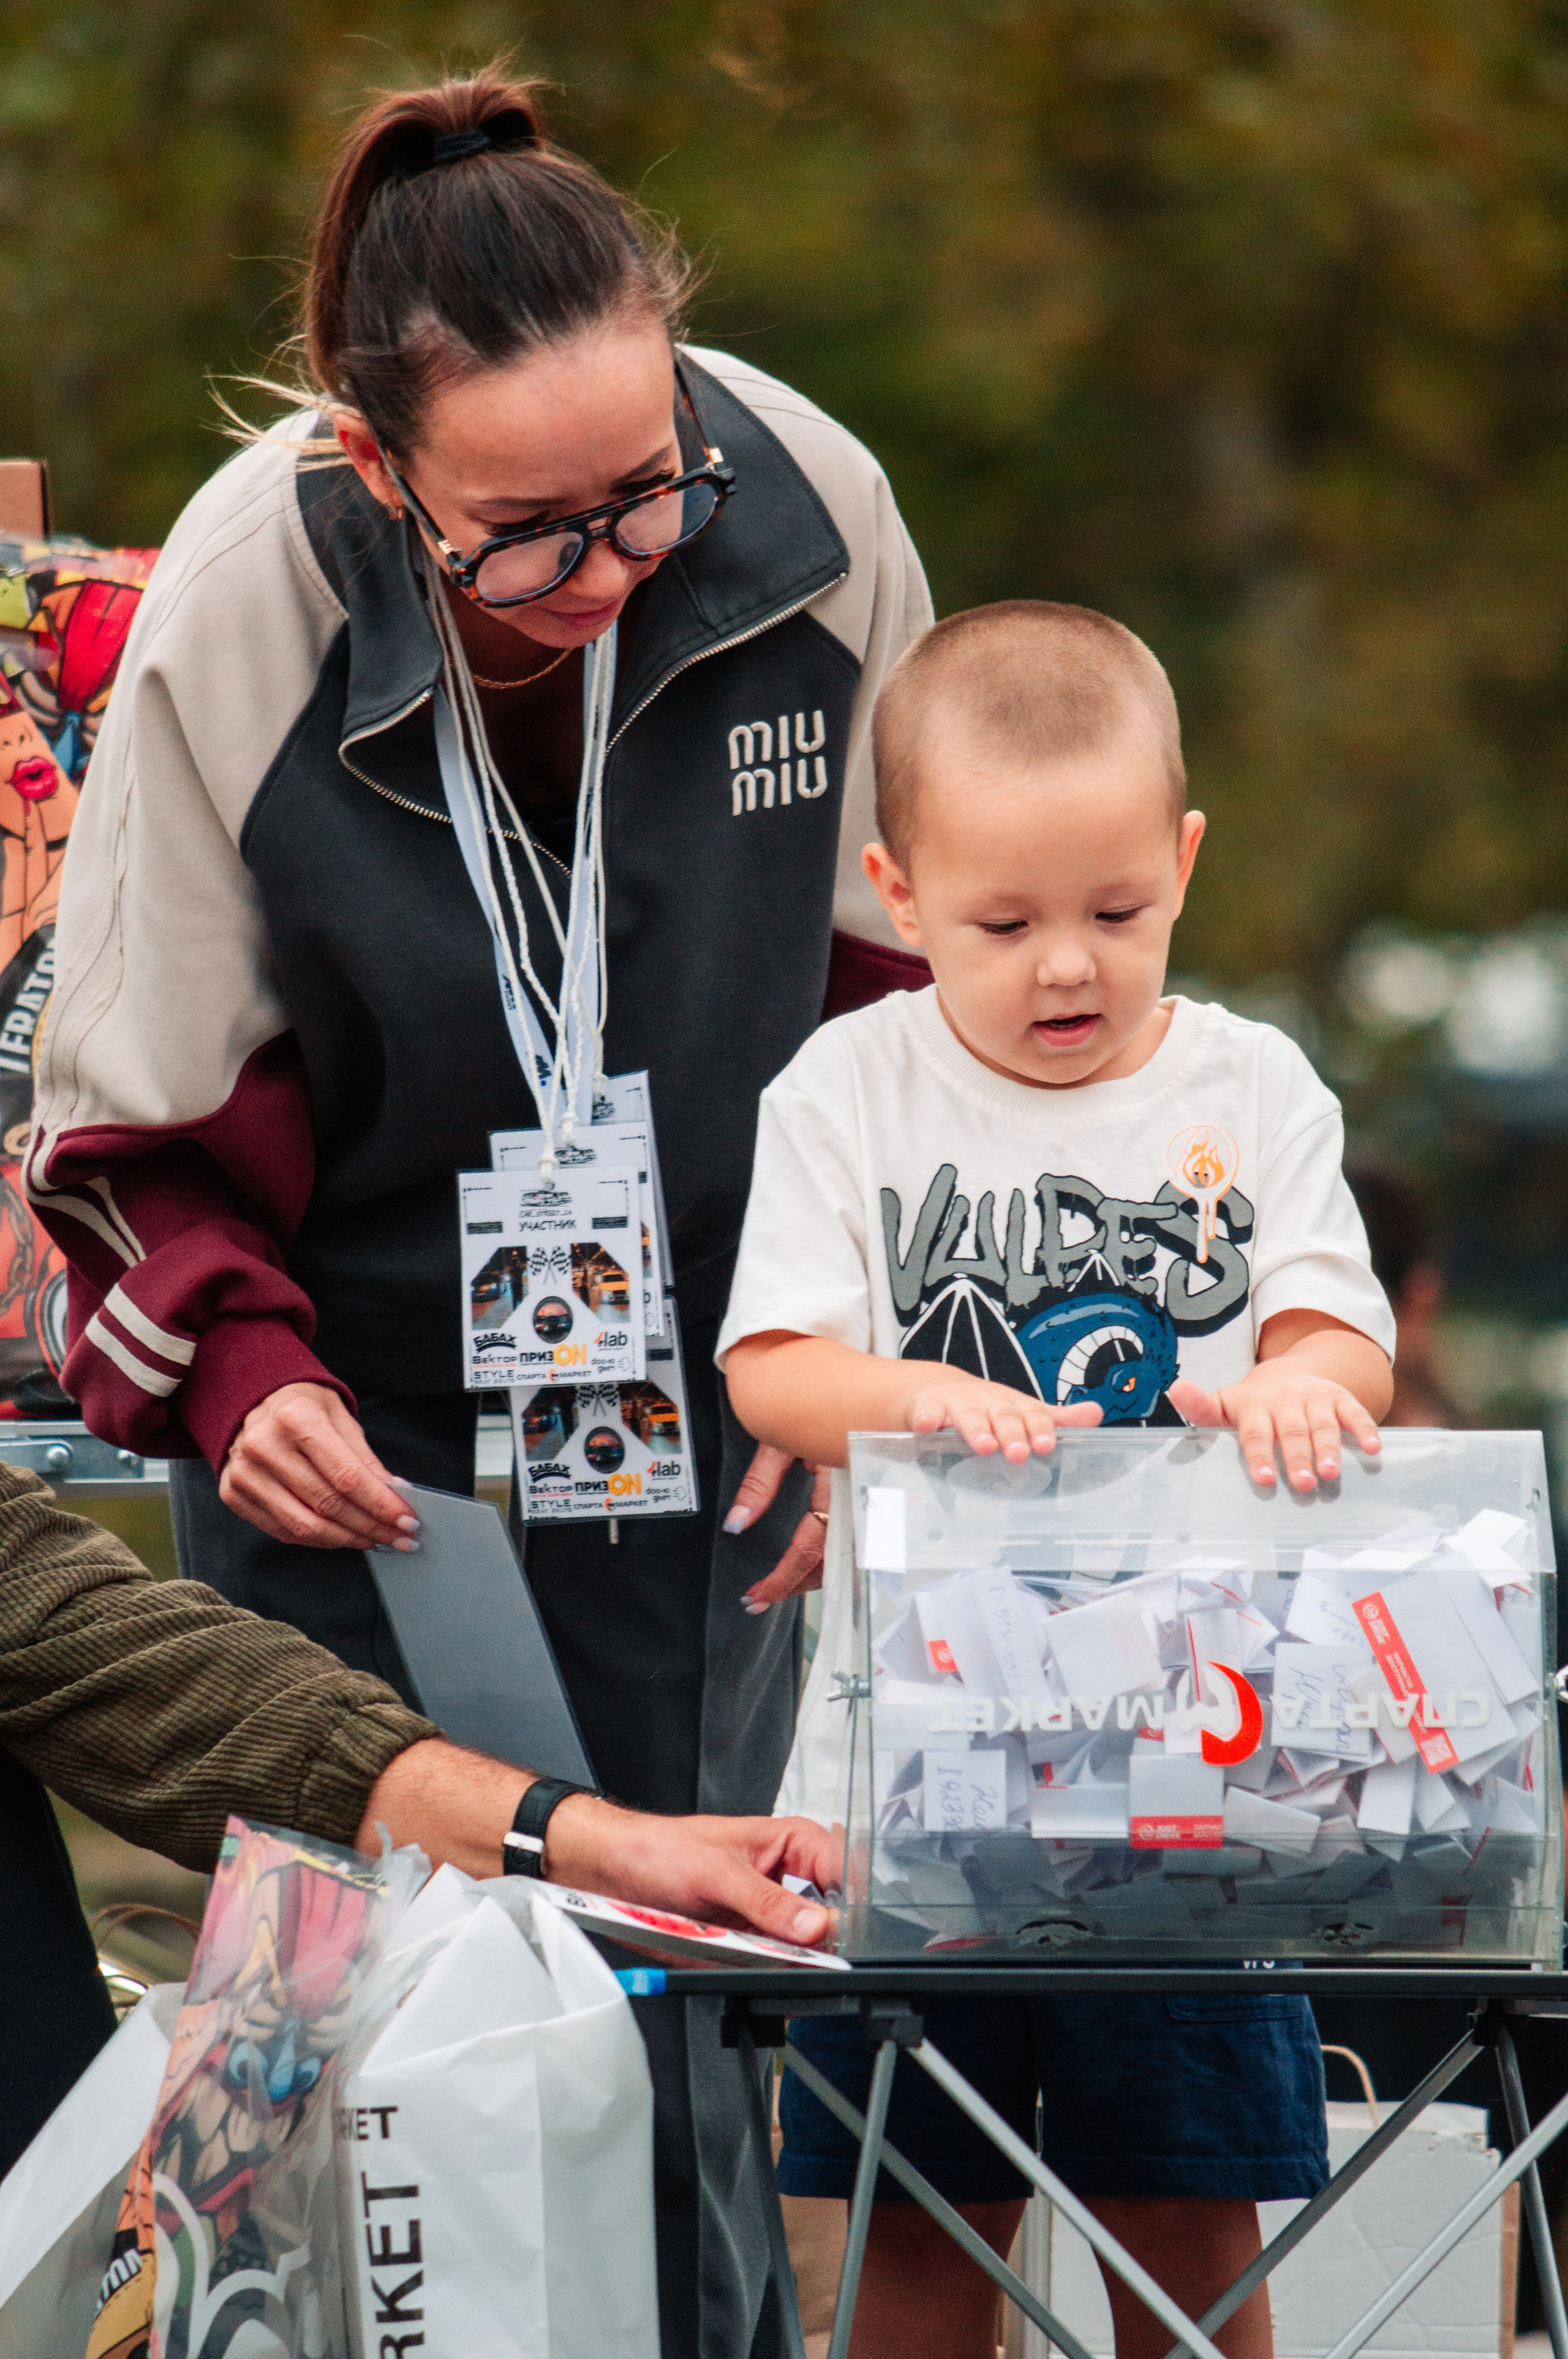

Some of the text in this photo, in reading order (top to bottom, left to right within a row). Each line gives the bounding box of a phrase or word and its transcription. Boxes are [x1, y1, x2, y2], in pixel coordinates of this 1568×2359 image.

[519, 1219, 577, 1232] УЧАСТНИК
[473, 1332, 516, 1347] БАБАХ
[473, 1370, 514, 1380] STYLE
[528, 1463, 571, 1478] БАБАХ
[531, 1499, 571, 1509] STYLE
[929, 1695, 1164, 1732] МАРКЕТ
[1270, 1693, 1490, 1729] СПАРТА
